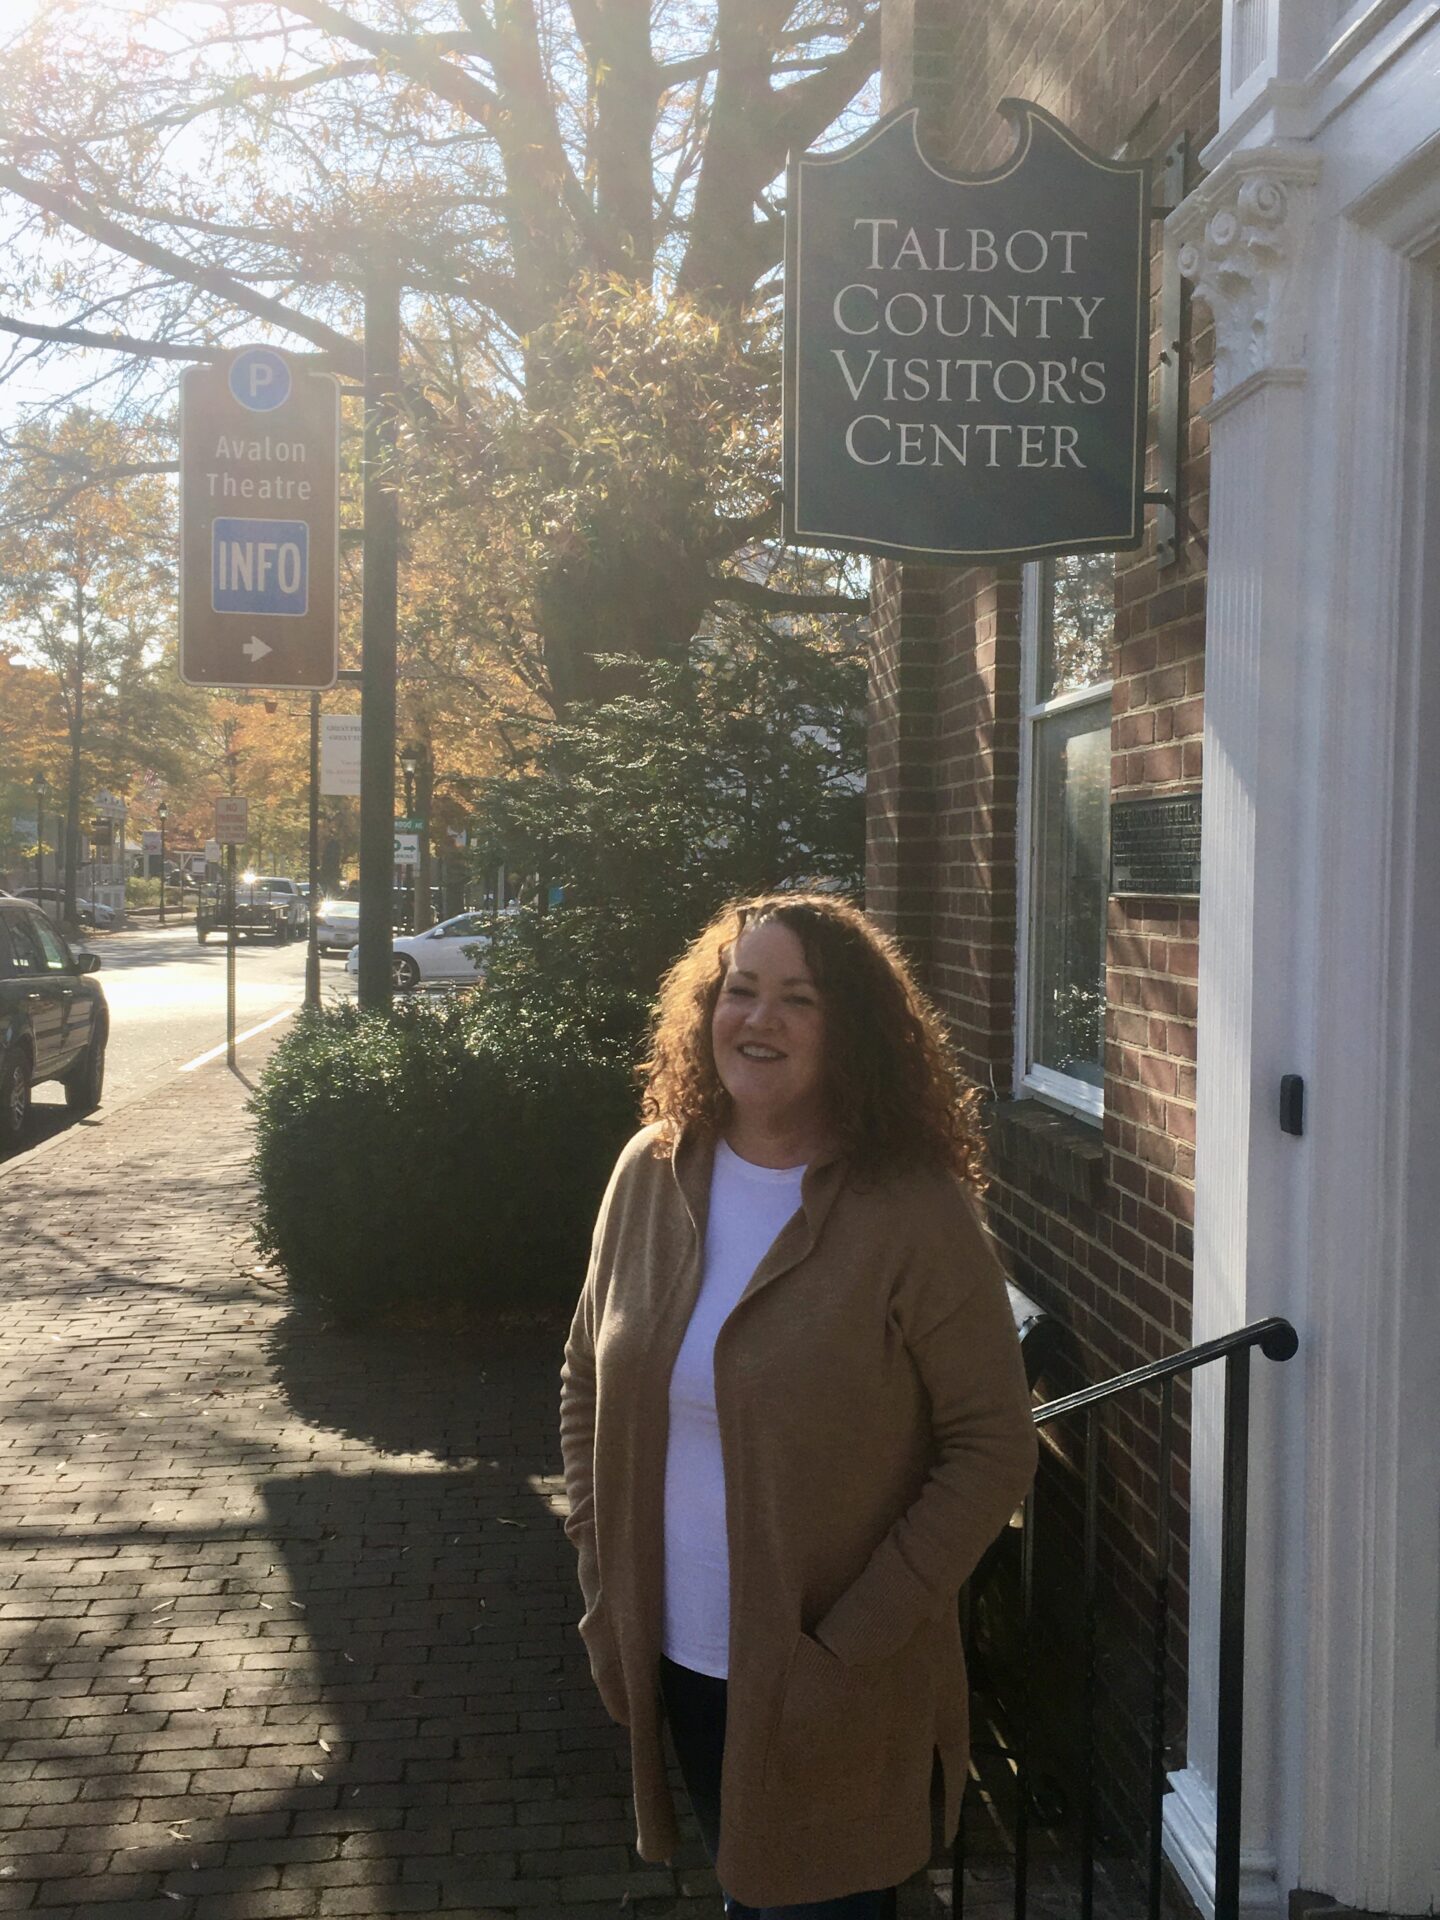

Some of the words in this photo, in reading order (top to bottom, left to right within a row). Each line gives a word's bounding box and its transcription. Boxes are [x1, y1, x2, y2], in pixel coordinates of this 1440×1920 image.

[853, 218, 1088, 274] TALBOT
[832, 284, 1106, 340] COUNTY
[249, 362, 273, 397] P
[830, 349, 1106, 405] VISITOR'S
[215, 435, 306, 462] Avalon
[845, 414, 1087, 469] CENTER
[206, 472, 312, 500] Theatre
[219, 541, 301, 593] INFO
